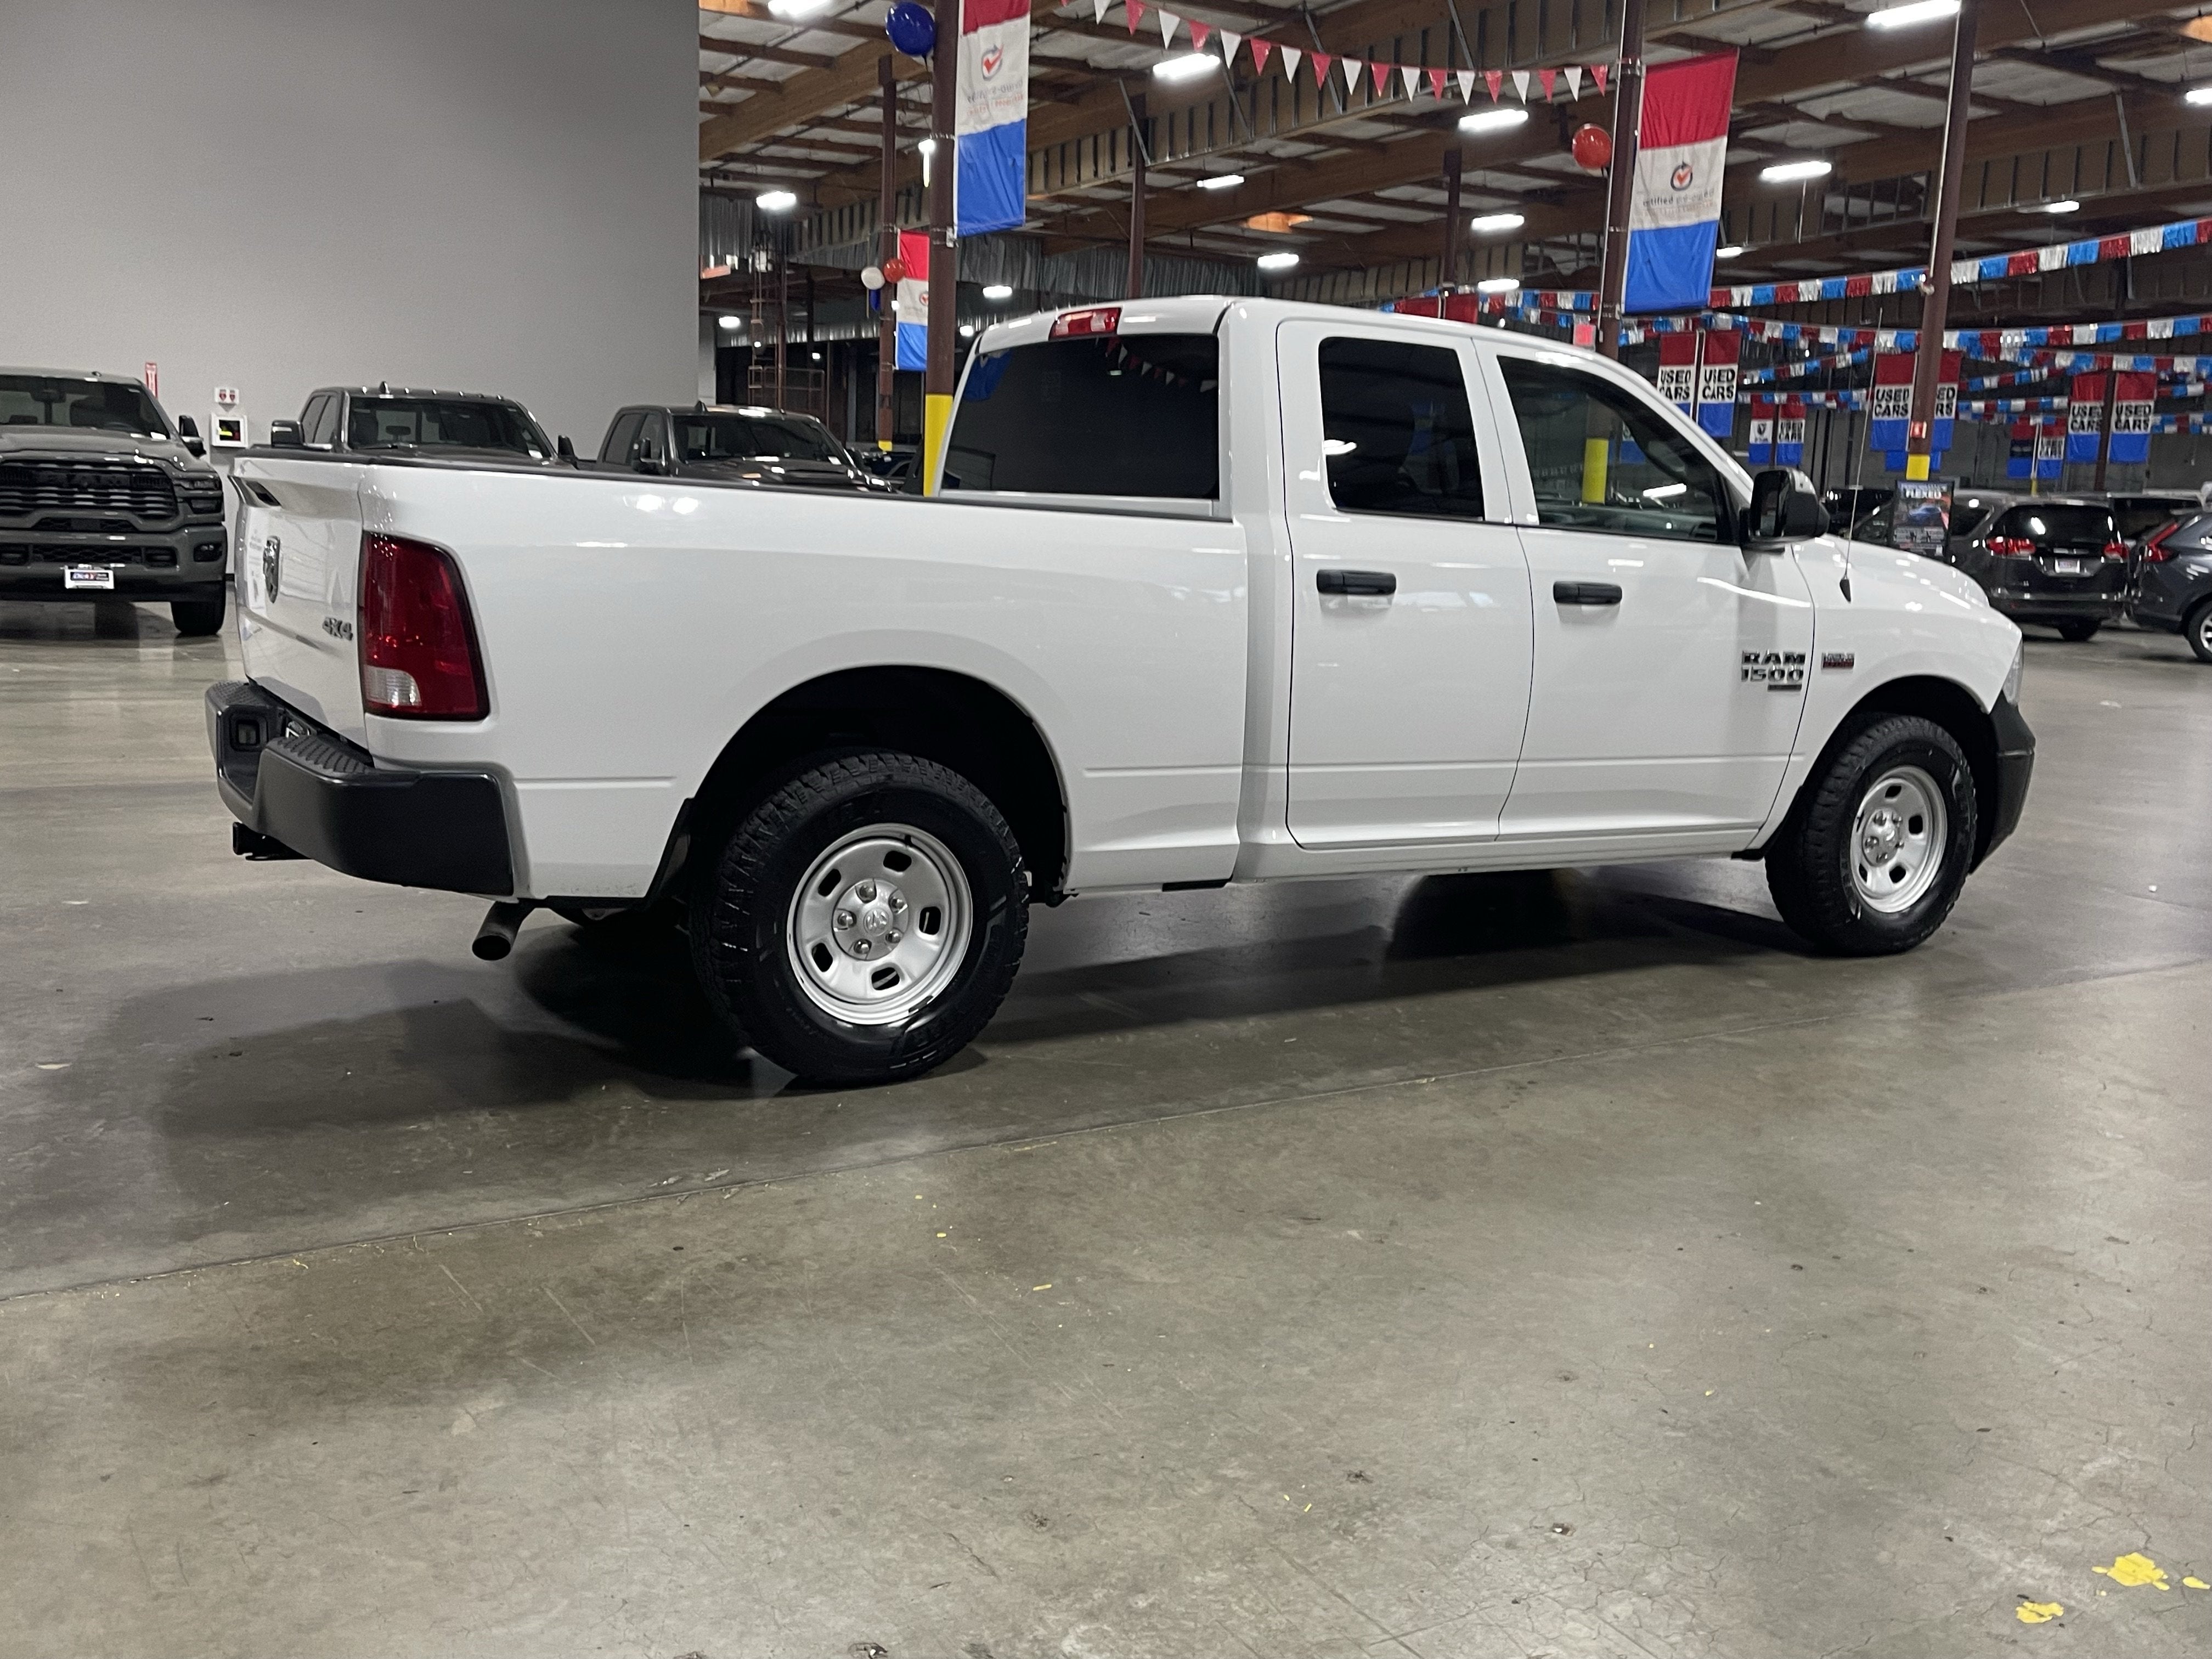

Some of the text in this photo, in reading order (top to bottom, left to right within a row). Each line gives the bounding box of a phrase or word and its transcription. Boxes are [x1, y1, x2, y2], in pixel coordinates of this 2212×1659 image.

[1661, 369, 1691, 383] USED
[1704, 369, 1735, 384] USED
[1702, 385, 1734, 399] CARS
[1875, 388, 1910, 402] USED
[1937, 386, 1956, 403] ED
[1874, 403, 1909, 417] CARS
[1936, 403, 1953, 417] RS
[2115, 404, 2152, 418] USED
[2114, 419, 2151, 432] CARS
[1742, 651, 1805, 665] RAM
[1741, 665, 1804, 682] 1500
